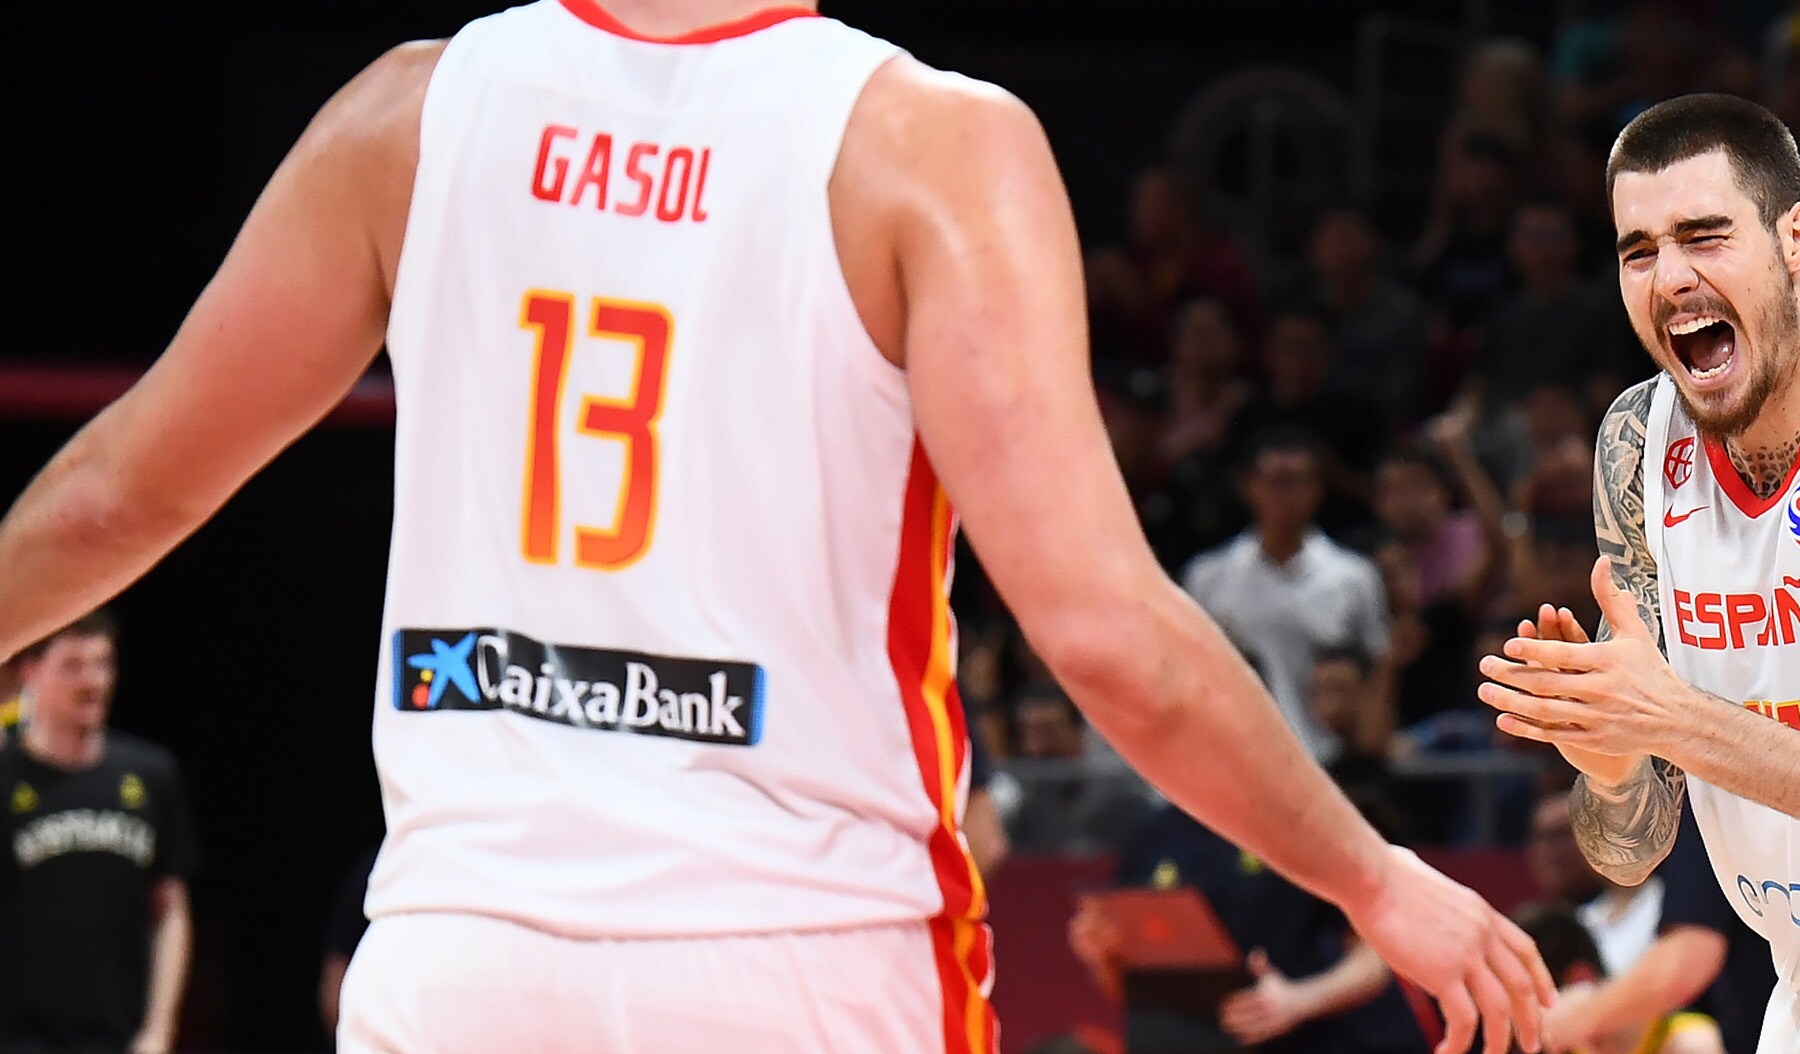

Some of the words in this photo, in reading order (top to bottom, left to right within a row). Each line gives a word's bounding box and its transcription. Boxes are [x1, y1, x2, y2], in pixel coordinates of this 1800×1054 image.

[531, 123, 711, 222] GASOL
[519, 287, 675, 572] 13
[476, 634, 747, 738] CaixaBank
